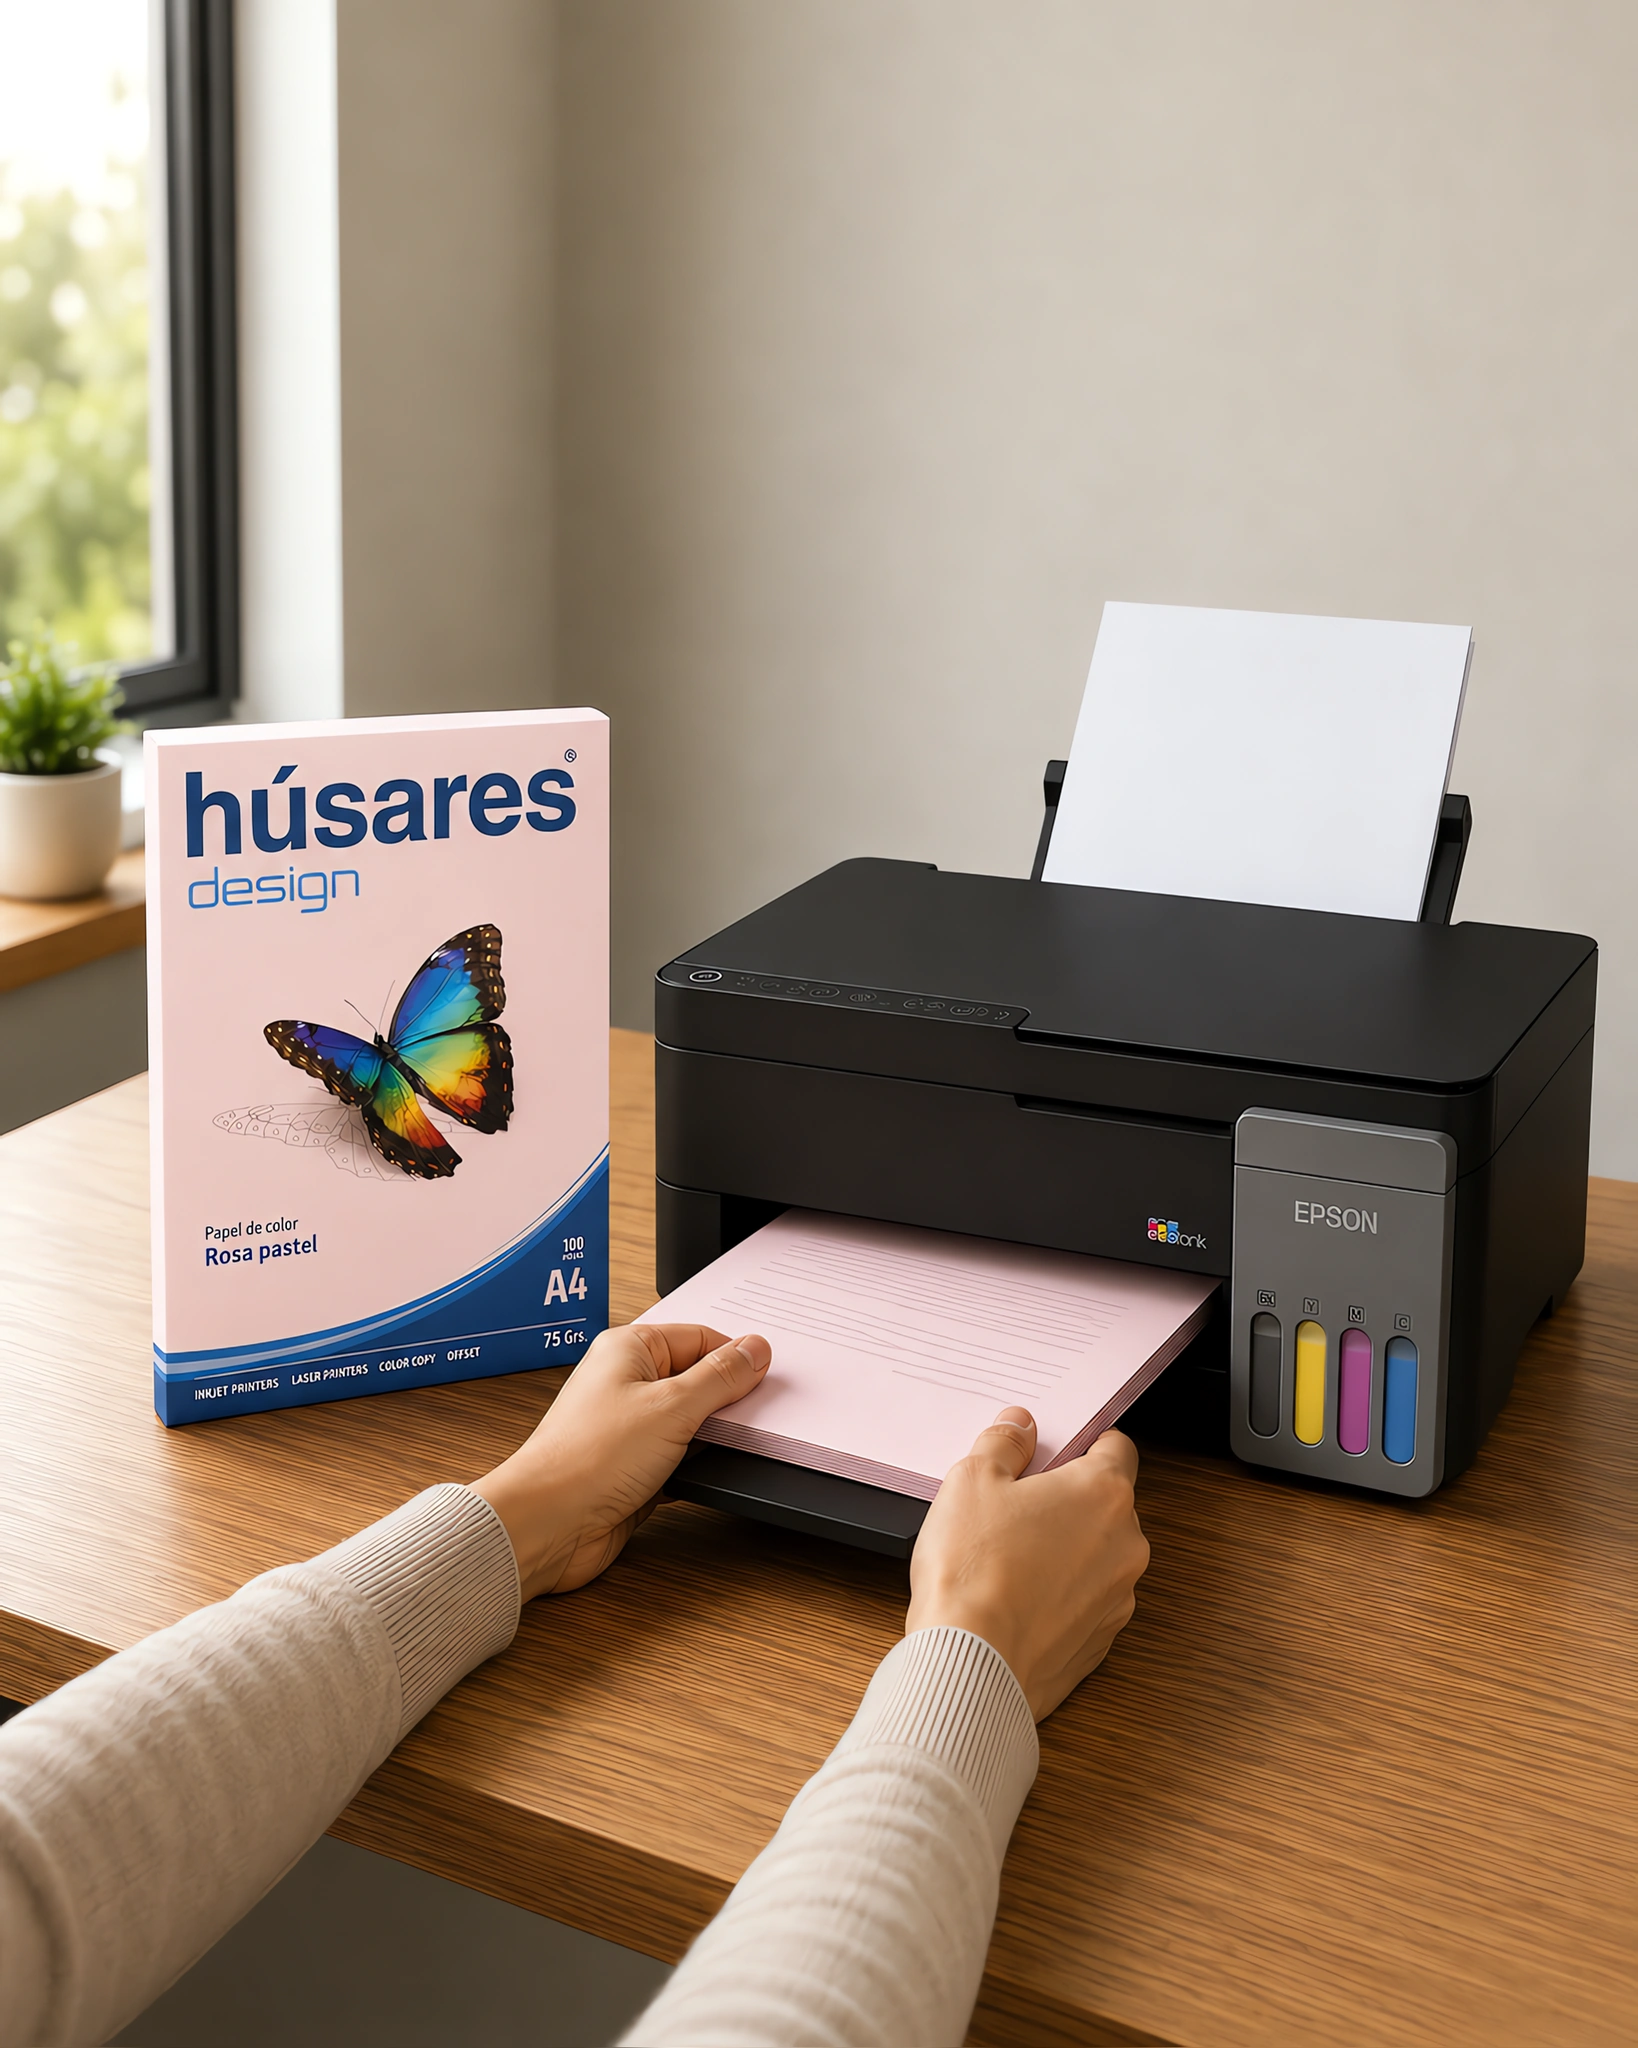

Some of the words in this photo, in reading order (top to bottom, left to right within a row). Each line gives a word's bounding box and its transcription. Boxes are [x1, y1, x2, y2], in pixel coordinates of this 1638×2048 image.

[185, 764, 578, 858] húsares
[187, 866, 361, 914] design
[205, 1221, 242, 1242] Papel
[246, 1220, 263, 1236] de
[265, 1216, 299, 1234] color
[1294, 1200, 1378, 1234] EPSON
[205, 1247, 253, 1267] Rosa
[259, 1233, 318, 1265] pastel
[562, 1236, 585, 1253] 100
[543, 1266, 588, 1306] A4
[543, 1330, 561, 1349] 75
[564, 1329, 588, 1345] Grs.
[378, 1356, 410, 1373] COLOR
[194, 1385, 229, 1401] INKJET
